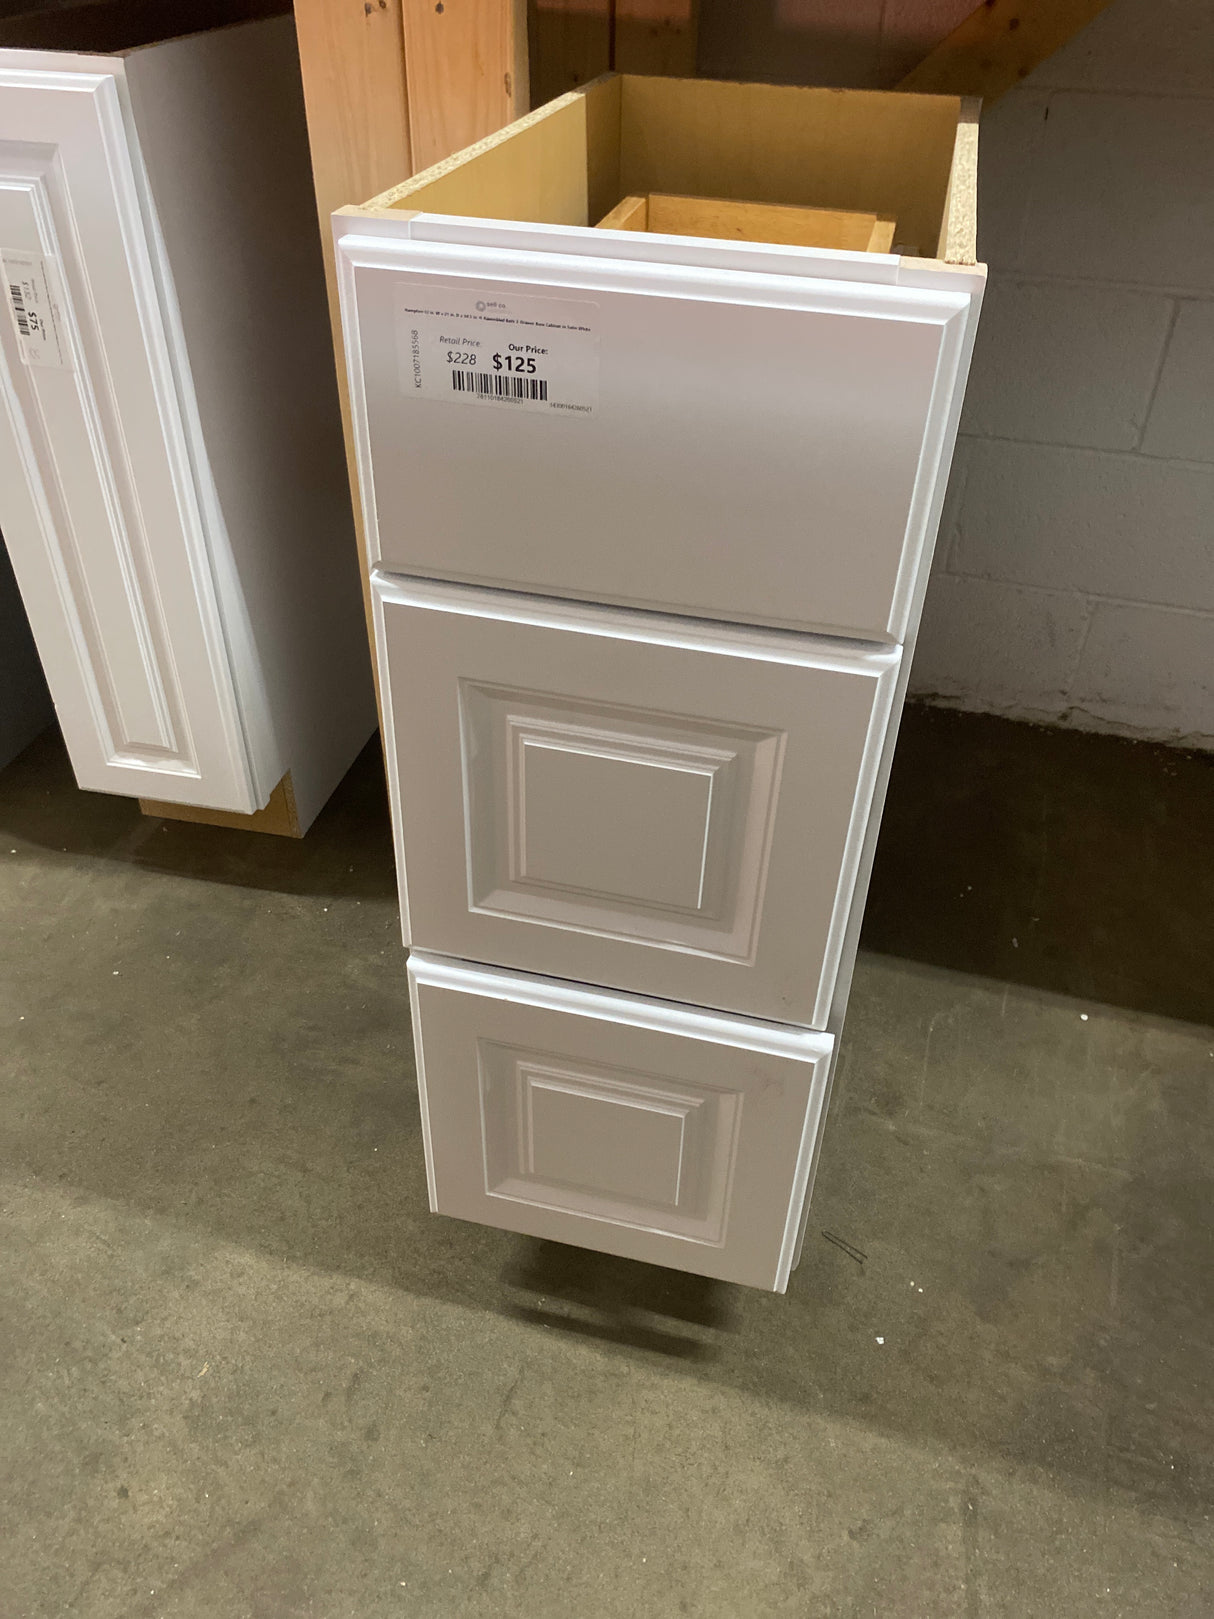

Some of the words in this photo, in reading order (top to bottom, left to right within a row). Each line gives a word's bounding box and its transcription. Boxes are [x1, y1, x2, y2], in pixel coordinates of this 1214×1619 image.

[27, 311, 39, 331] $75
[439, 335, 461, 345] Retail
[508, 343, 524, 352] Our
[525, 345, 549, 355] Price:
[446, 351, 477, 366] $228
[492, 352, 537, 374] $125
